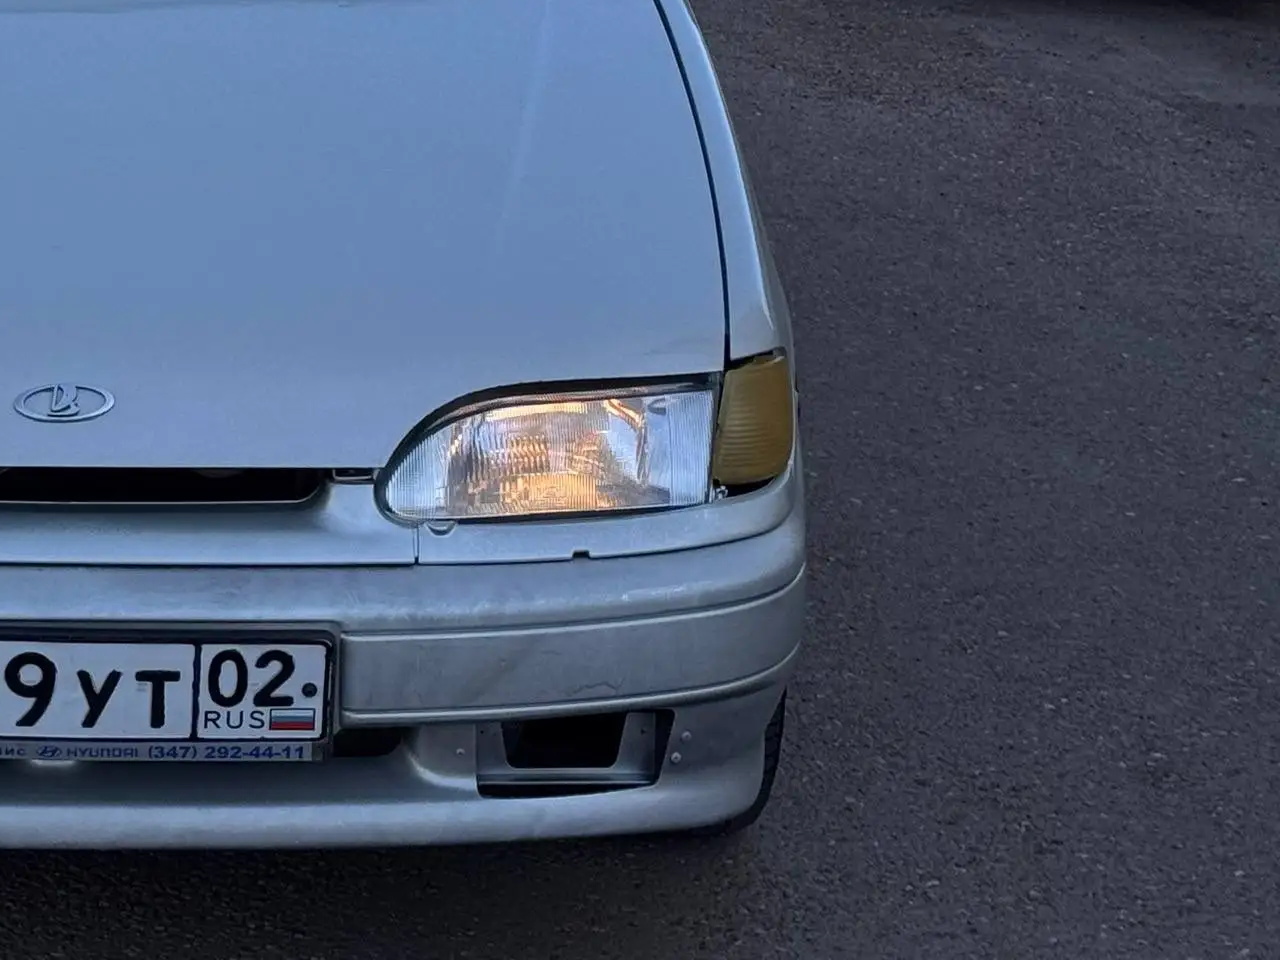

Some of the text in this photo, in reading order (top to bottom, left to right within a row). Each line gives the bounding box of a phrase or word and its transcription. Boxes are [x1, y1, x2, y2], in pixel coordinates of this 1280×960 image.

[207, 648, 296, 709] 02
[204, 710, 266, 730] RUS
[66, 748, 138, 758] HYUNDAI
[148, 745, 198, 760] (347)
[204, 746, 304, 759] 292-44-11
